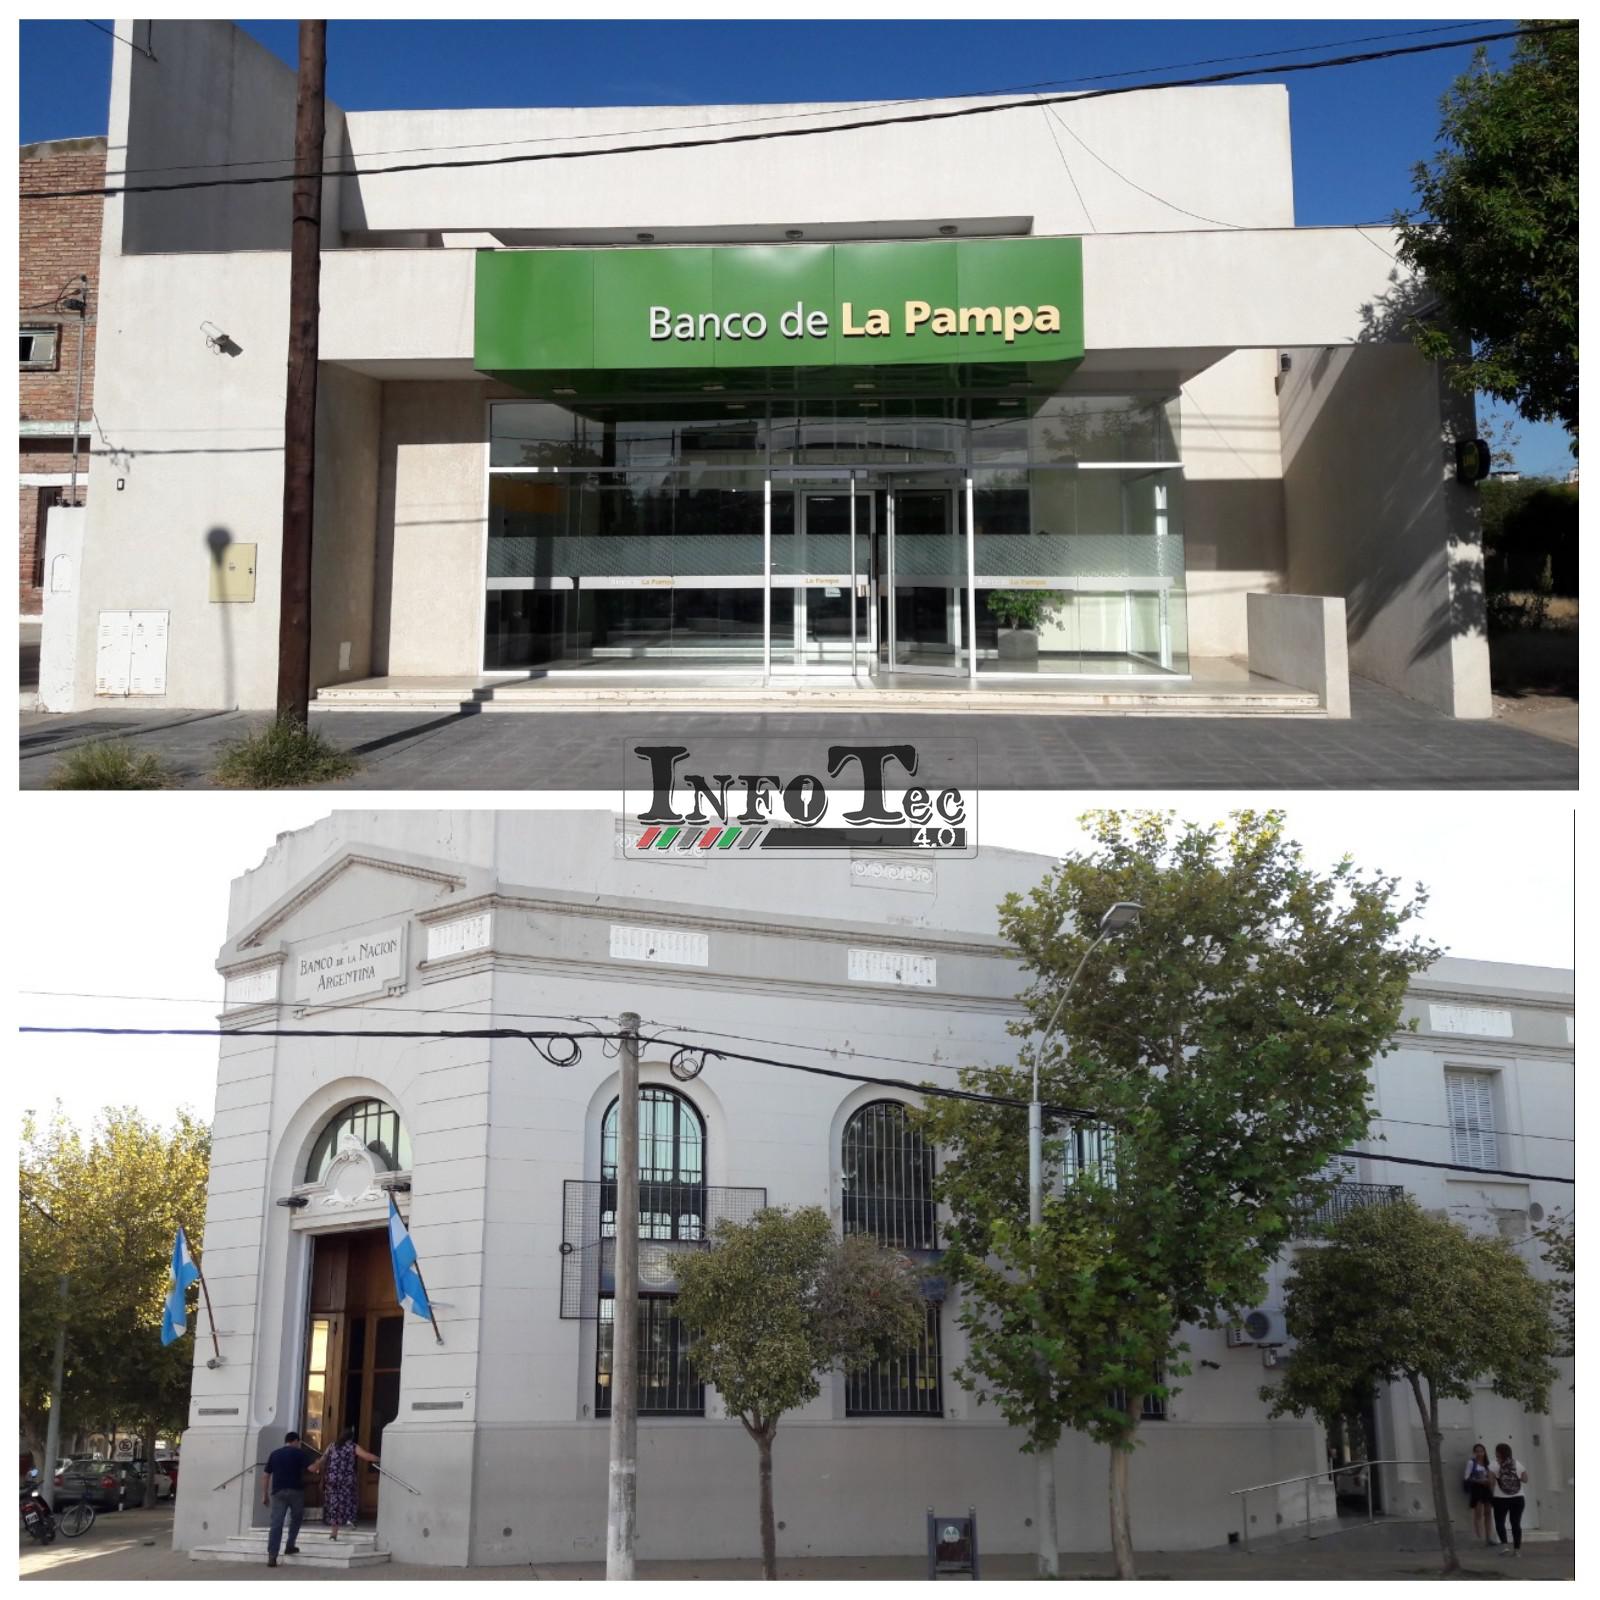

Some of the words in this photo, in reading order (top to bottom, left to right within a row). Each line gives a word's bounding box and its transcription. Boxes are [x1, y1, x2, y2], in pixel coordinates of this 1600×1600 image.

[649, 305, 768, 341] Banco
[779, 300, 830, 338] de
[841, 302, 891, 337] La
[904, 300, 1061, 344] Pampa
[300, 956, 333, 976] BANCO
[359, 939, 398, 961] NACION
[317, 965, 376, 992] ARGENTINA
